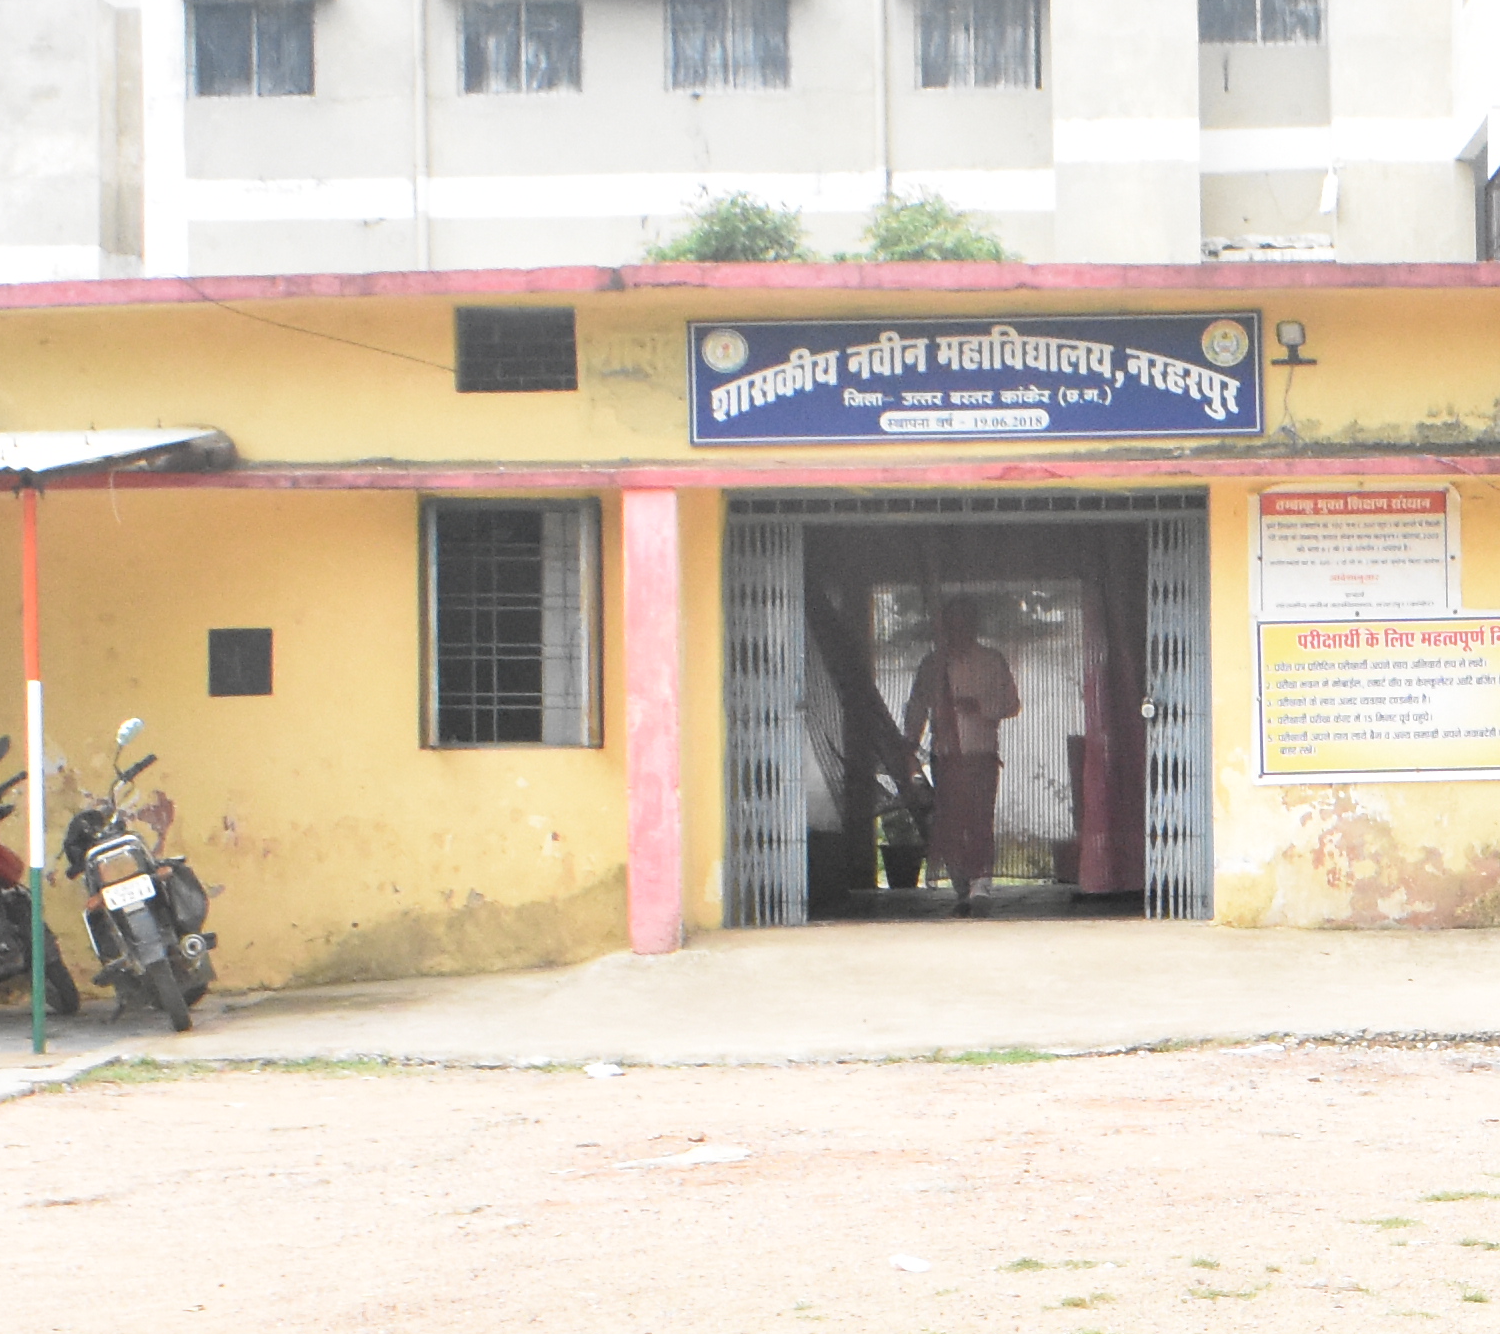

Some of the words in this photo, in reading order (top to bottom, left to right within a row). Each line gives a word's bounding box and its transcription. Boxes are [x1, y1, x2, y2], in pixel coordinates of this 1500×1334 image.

[711, 348, 840, 422] शासकीय
[846, 331, 929, 379] नवीन
[902, 391, 943, 406] उत्तर
[949, 391, 994, 407] बस्तर
[1000, 385, 1051, 406] कांकेर
[1058, 385, 1112, 406] (छ.ग.)
[935, 413, 955, 430] वर्ष
[972, 416, 1044, 430] 19.06.2018
[1318, 497, 1344, 514] मुक्त
[1297, 627, 1360, 650] परीक्षार्थी
[1365, 628, 1380, 648] के
[1384, 627, 1416, 648] लिए
[1420, 624, 1486, 653] महत्वपूर्ण
